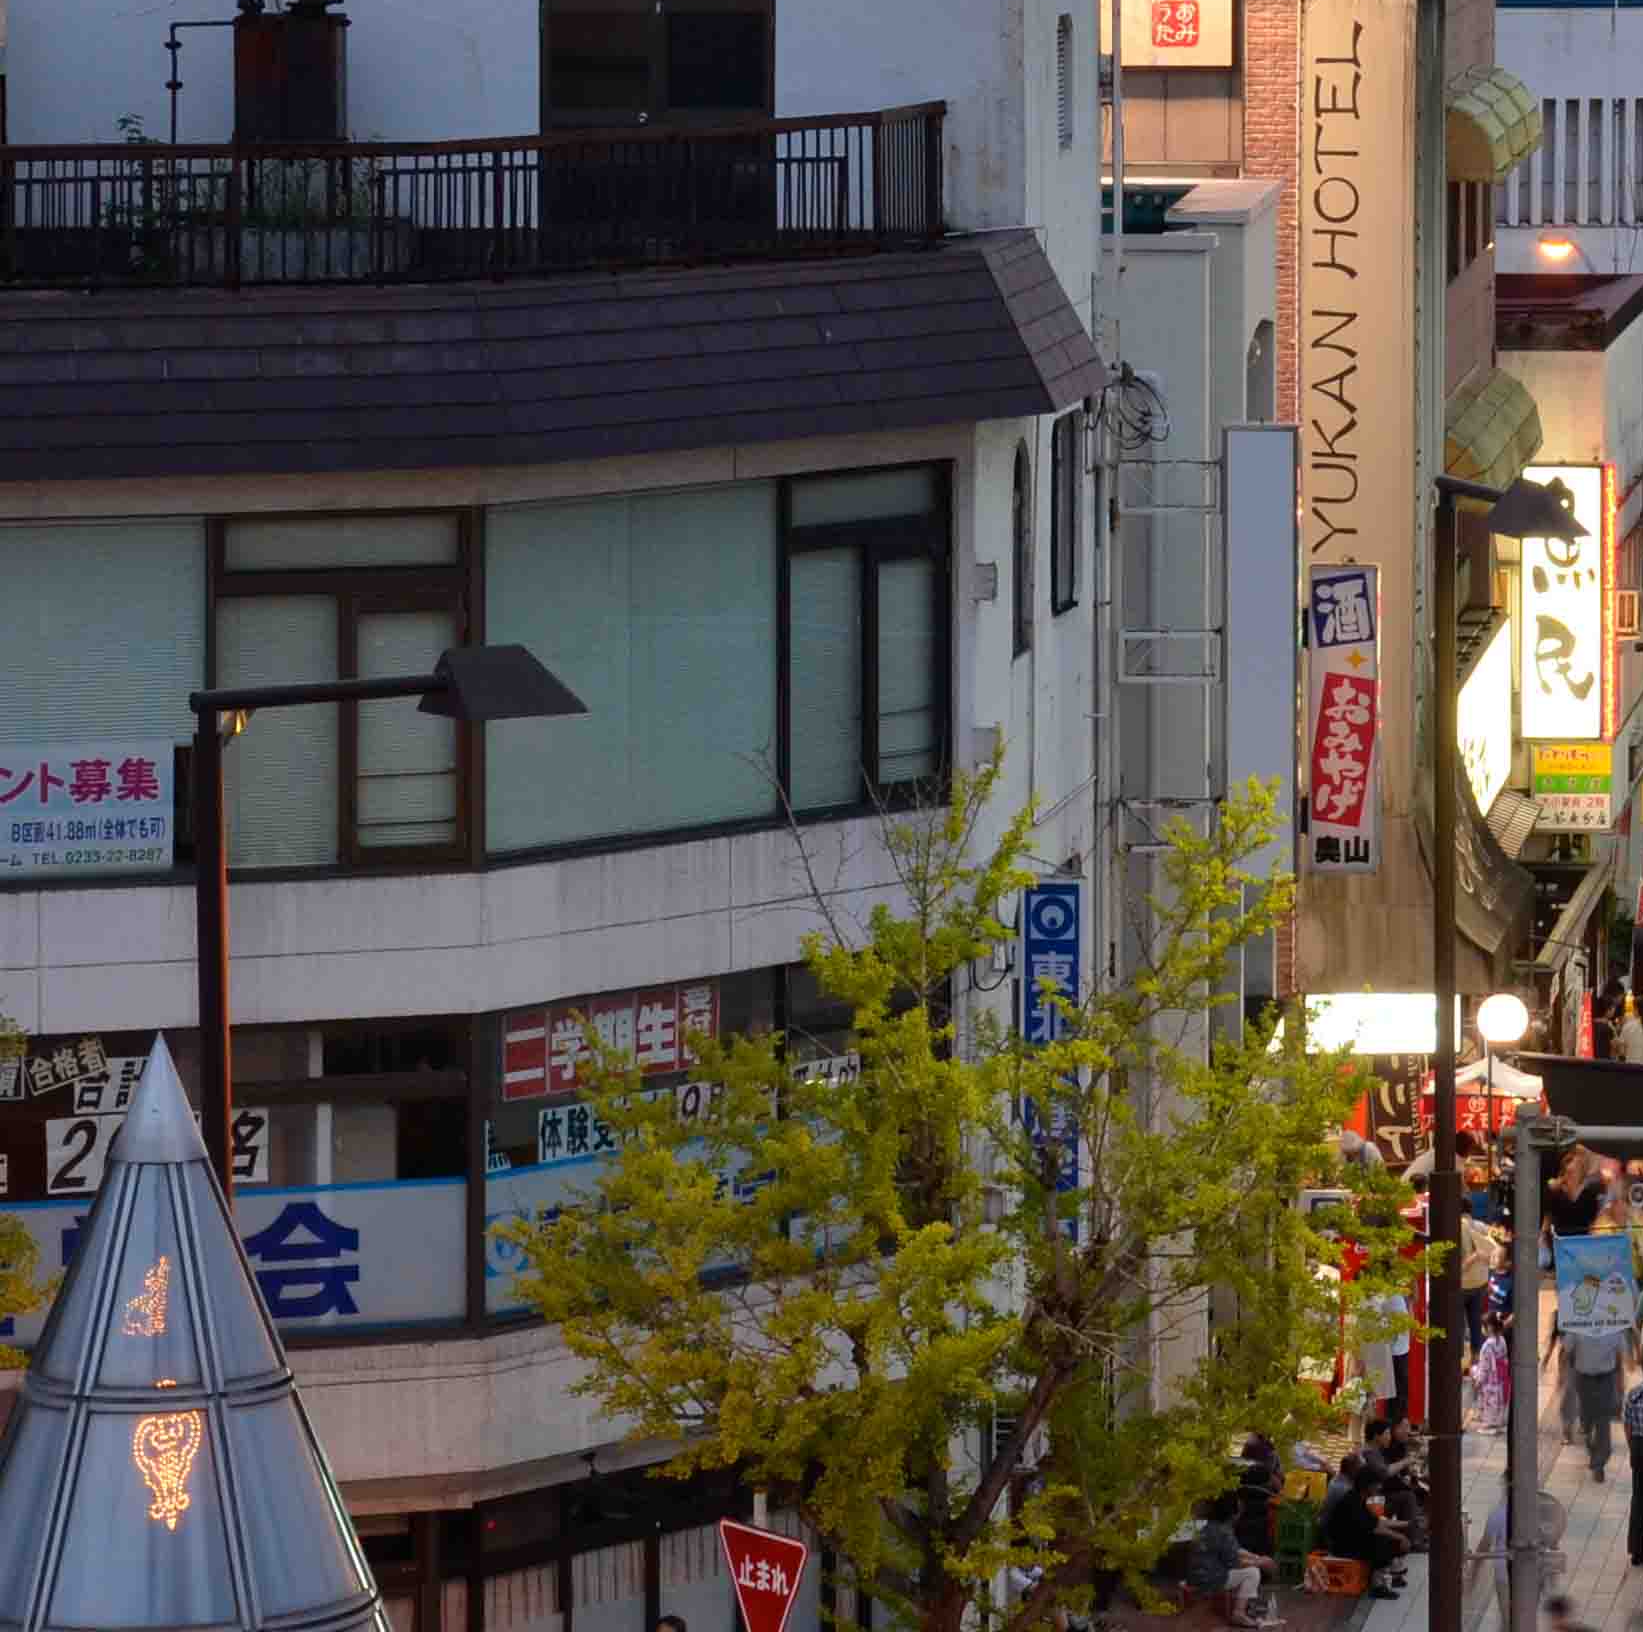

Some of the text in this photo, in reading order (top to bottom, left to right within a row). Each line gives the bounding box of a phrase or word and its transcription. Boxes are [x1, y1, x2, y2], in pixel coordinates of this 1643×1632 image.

[1311, 20, 1363, 554] YUKAN HOTEL
[1315, 578, 1371, 644] 酒
[1315, 677, 1371, 820] おみやげ
[1315, 834, 1370, 864] 奥山
[28, 1040, 108, 1090] 合格者
[739, 1554, 790, 1597] 止まれ
